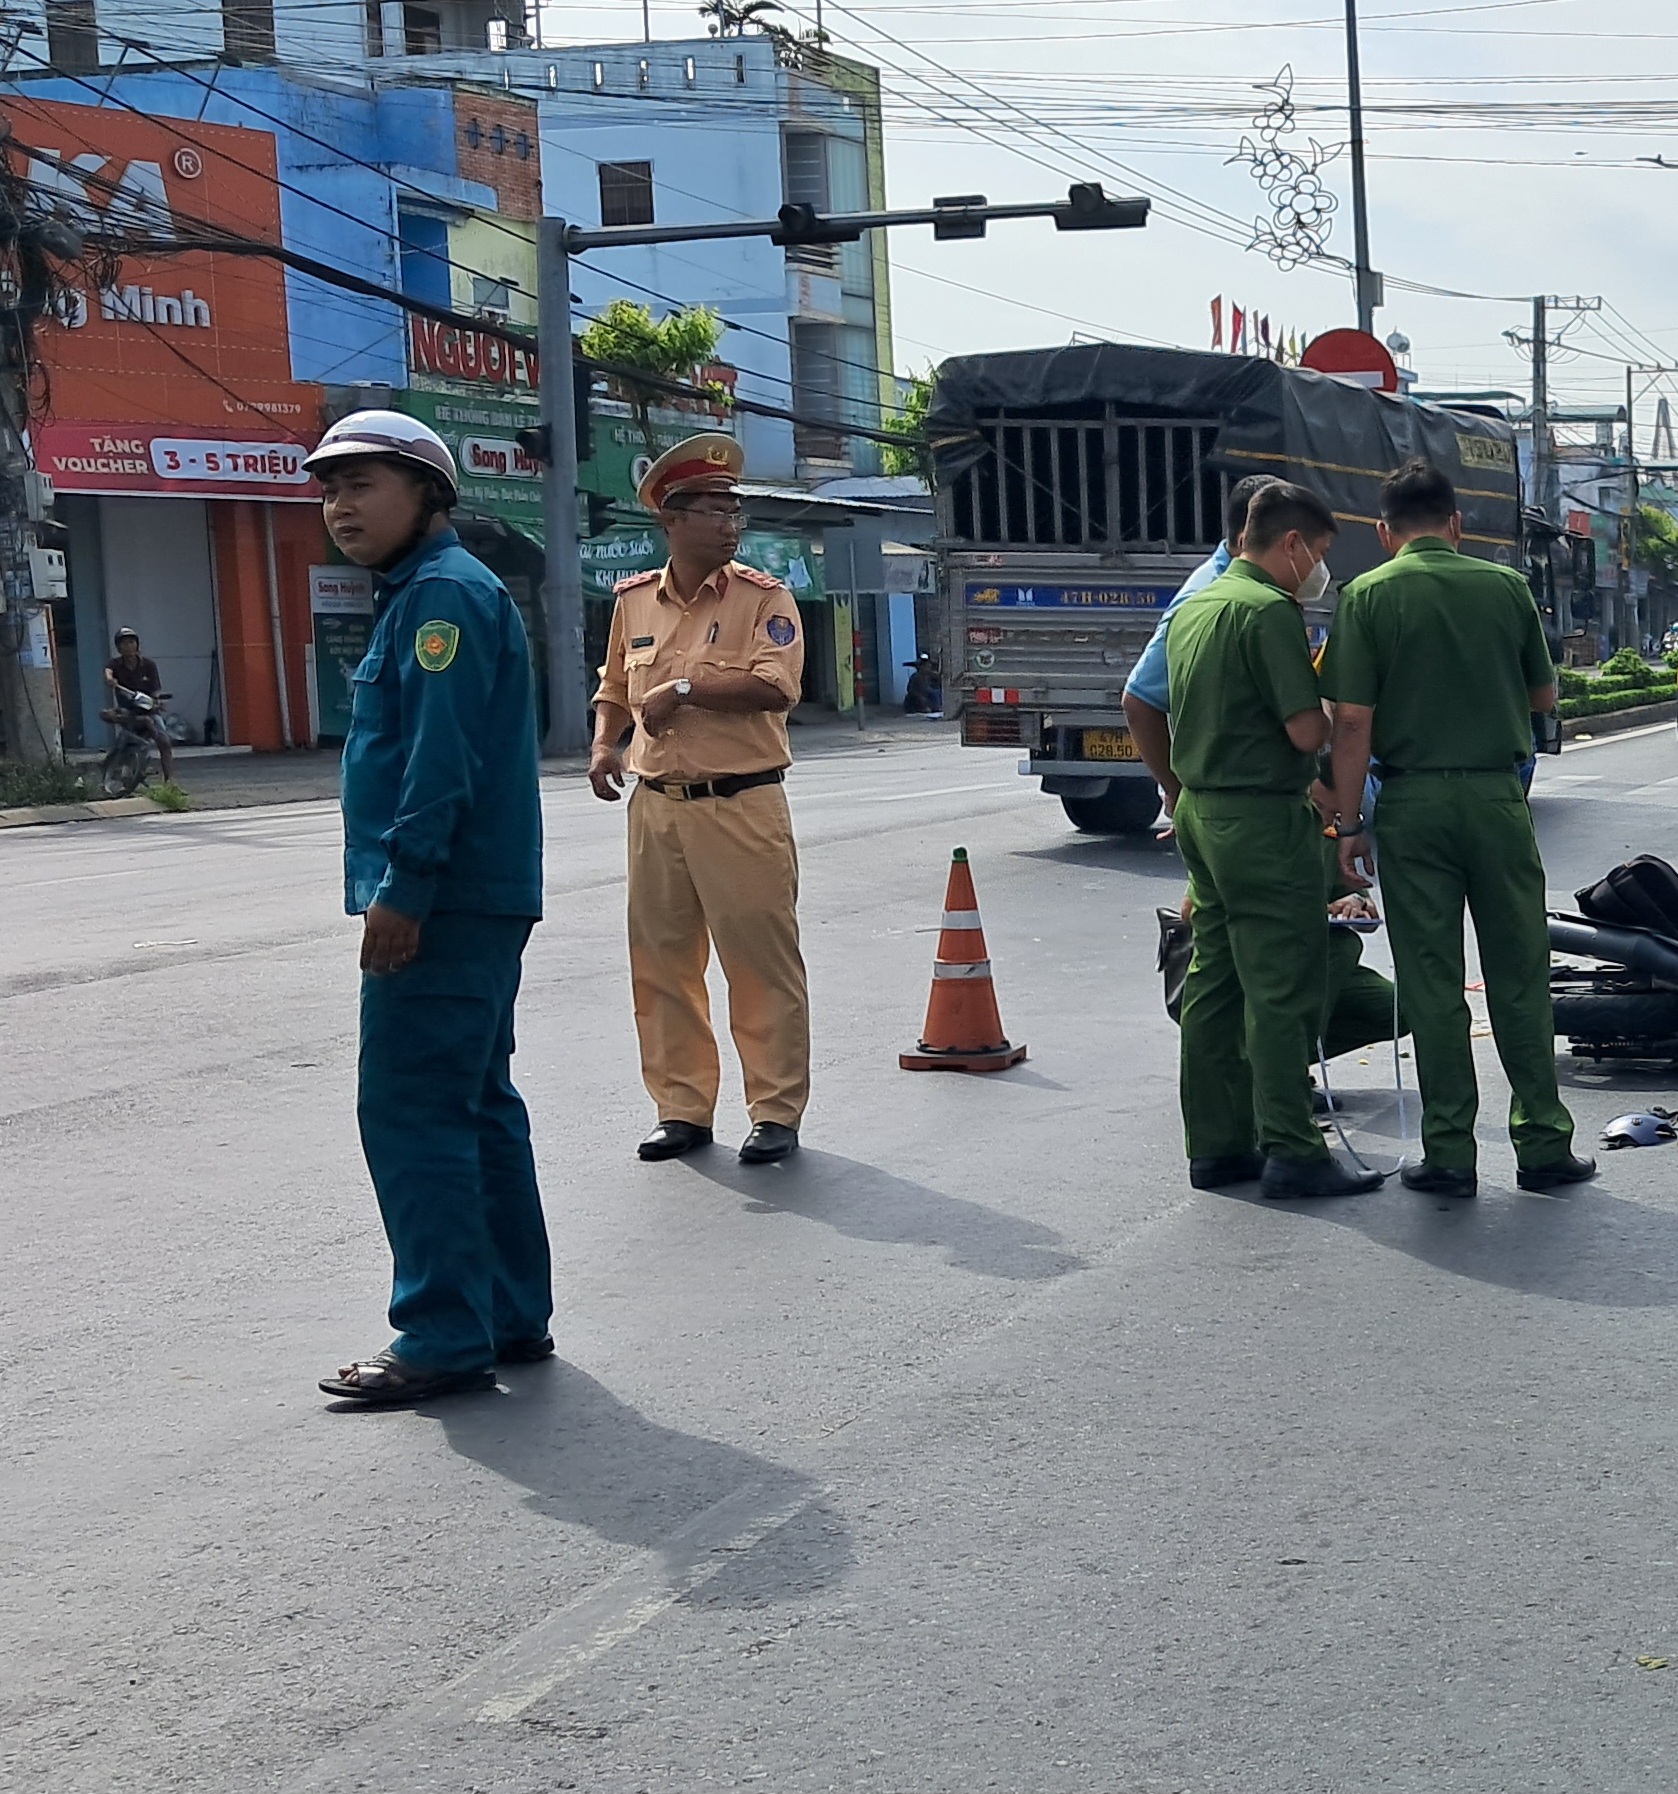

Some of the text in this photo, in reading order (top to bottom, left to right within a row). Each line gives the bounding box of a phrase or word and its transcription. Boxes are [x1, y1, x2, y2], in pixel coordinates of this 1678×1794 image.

[102, 284, 210, 327] Minh
[89, 435, 145, 456] TẶNG
[472, 443, 506, 473] Song
[51, 456, 149, 475] VOUCHER
[163, 450, 181, 470] 3
[205, 452, 220, 472] 5
[225, 449, 298, 480] TRIỆU
[595, 569, 615, 587] KHI
